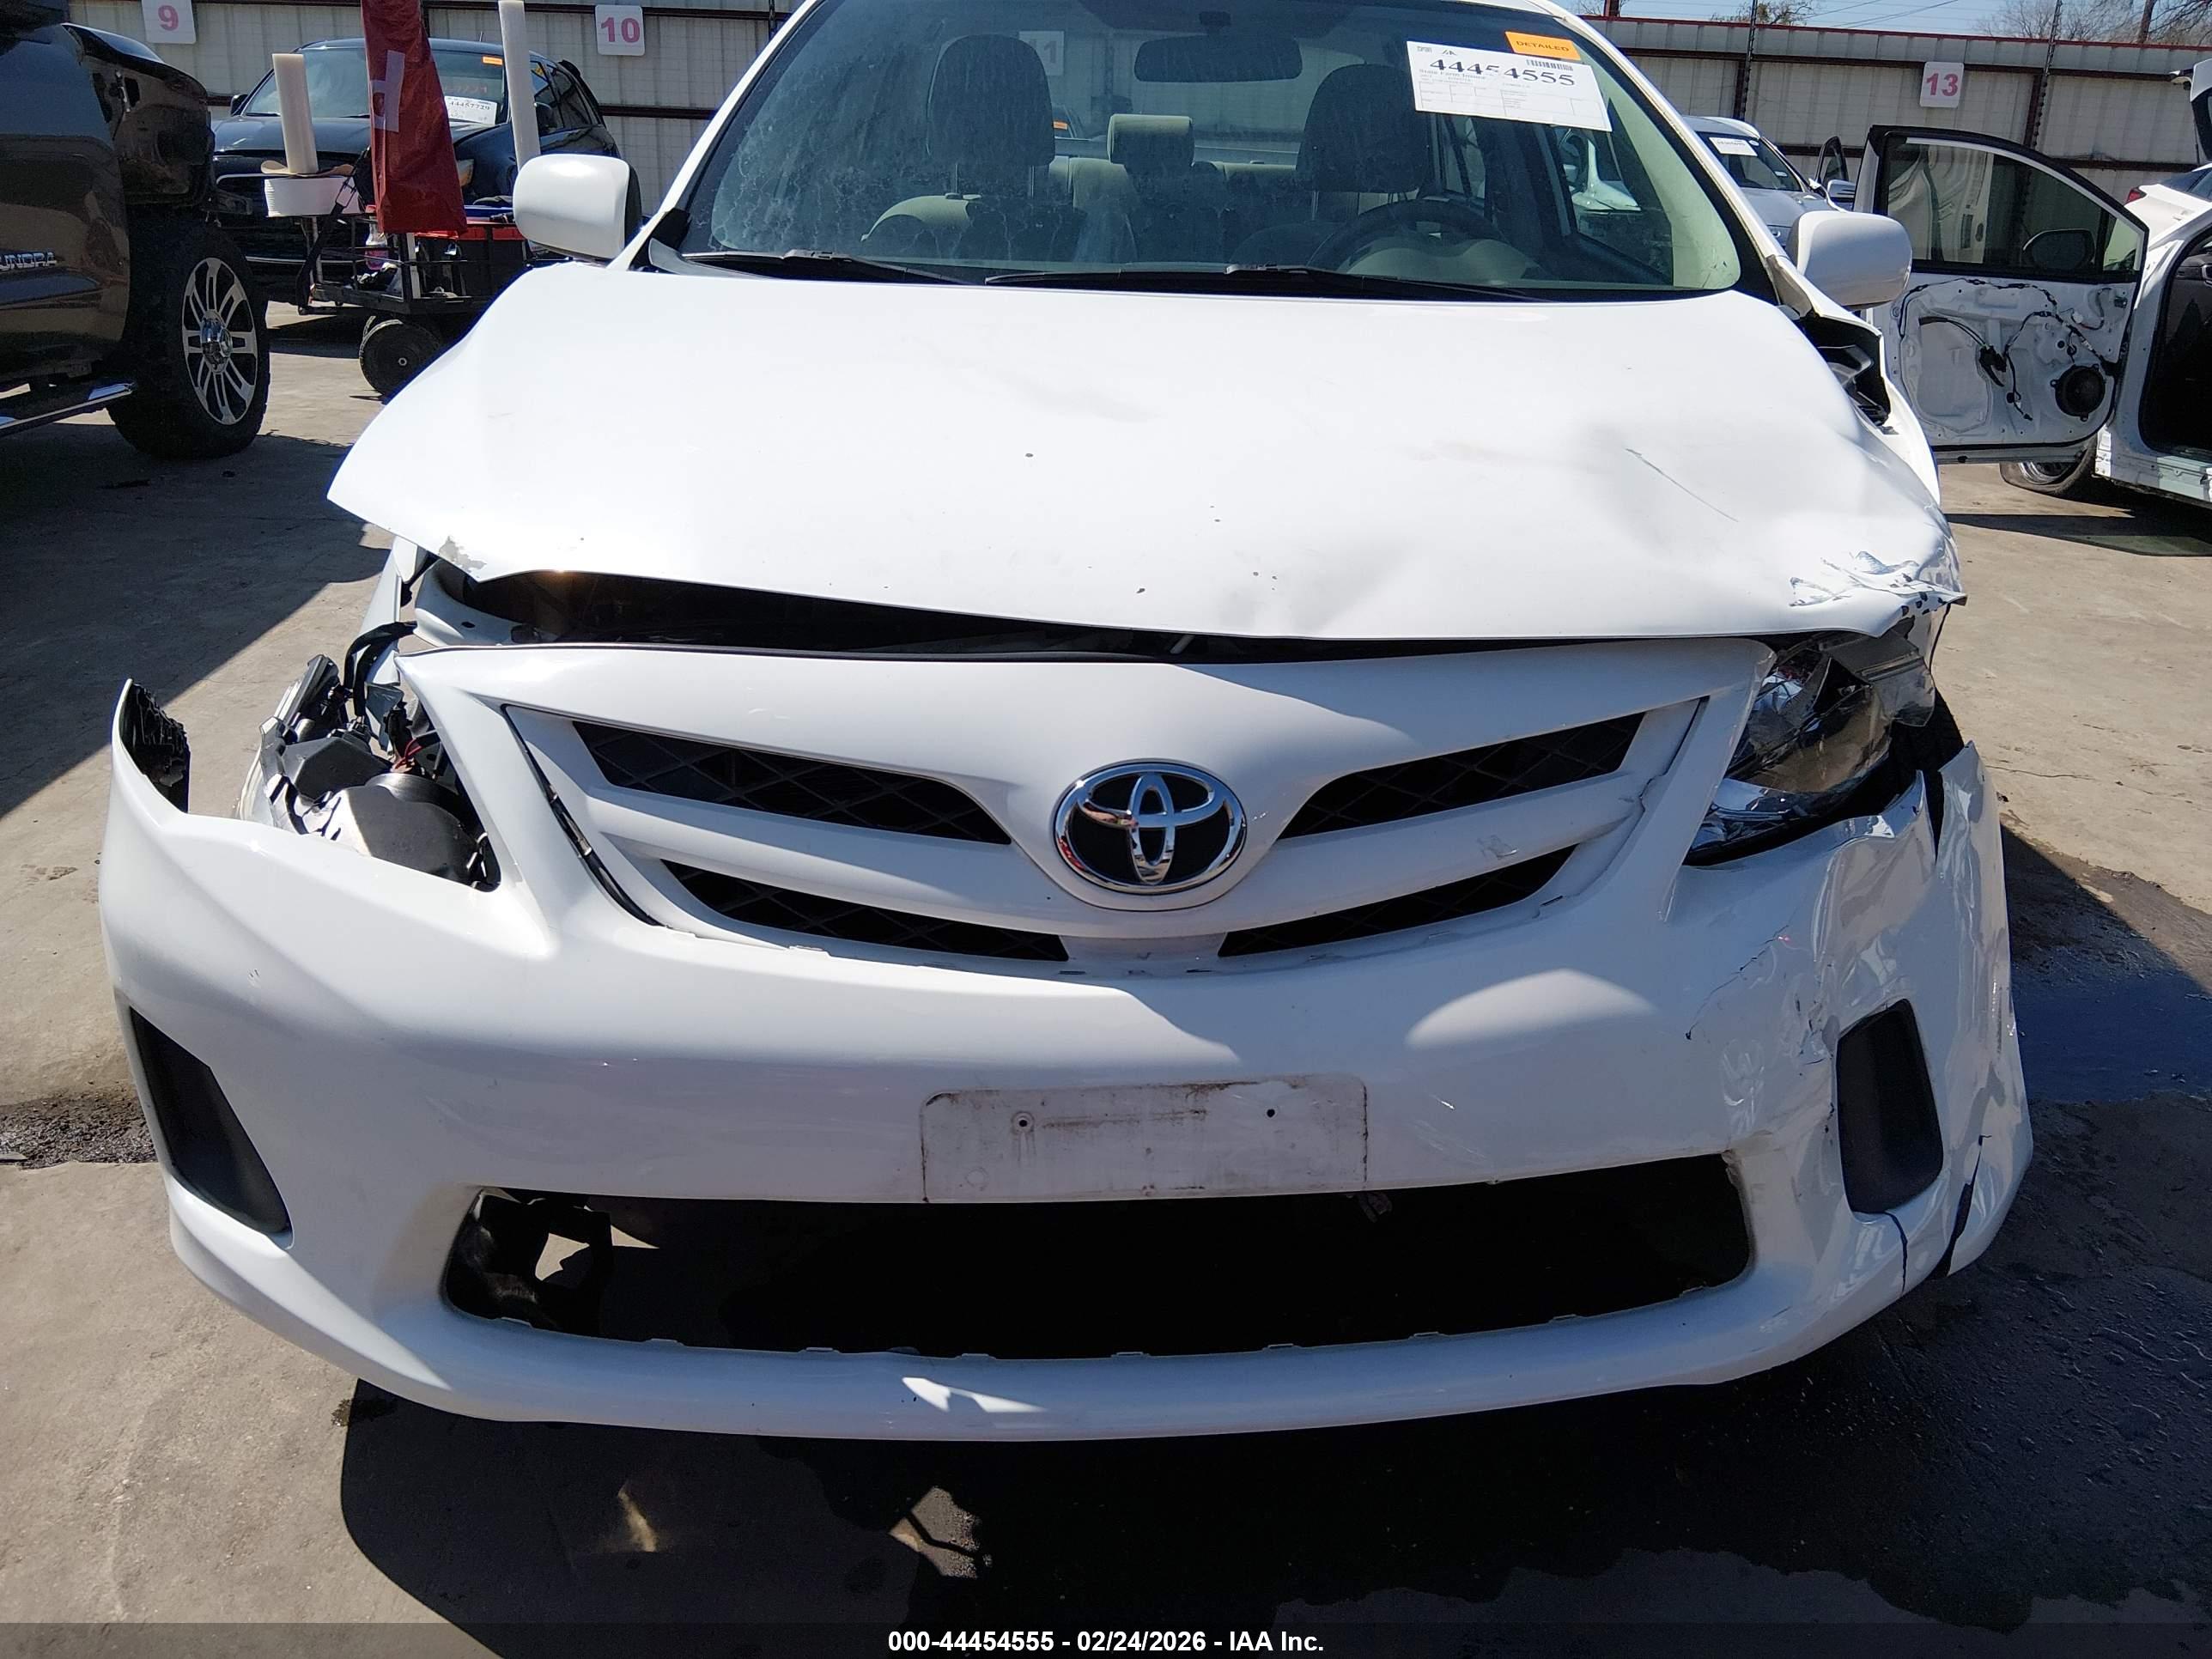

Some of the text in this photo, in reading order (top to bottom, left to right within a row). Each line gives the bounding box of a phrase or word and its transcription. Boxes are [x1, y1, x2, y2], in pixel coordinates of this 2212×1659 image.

[158, 5, 179, 31] 9
[601, 17, 640, 43] 10
[1516, 40, 1570, 52] DETAILED
[1926, 73, 1959, 97] 13
